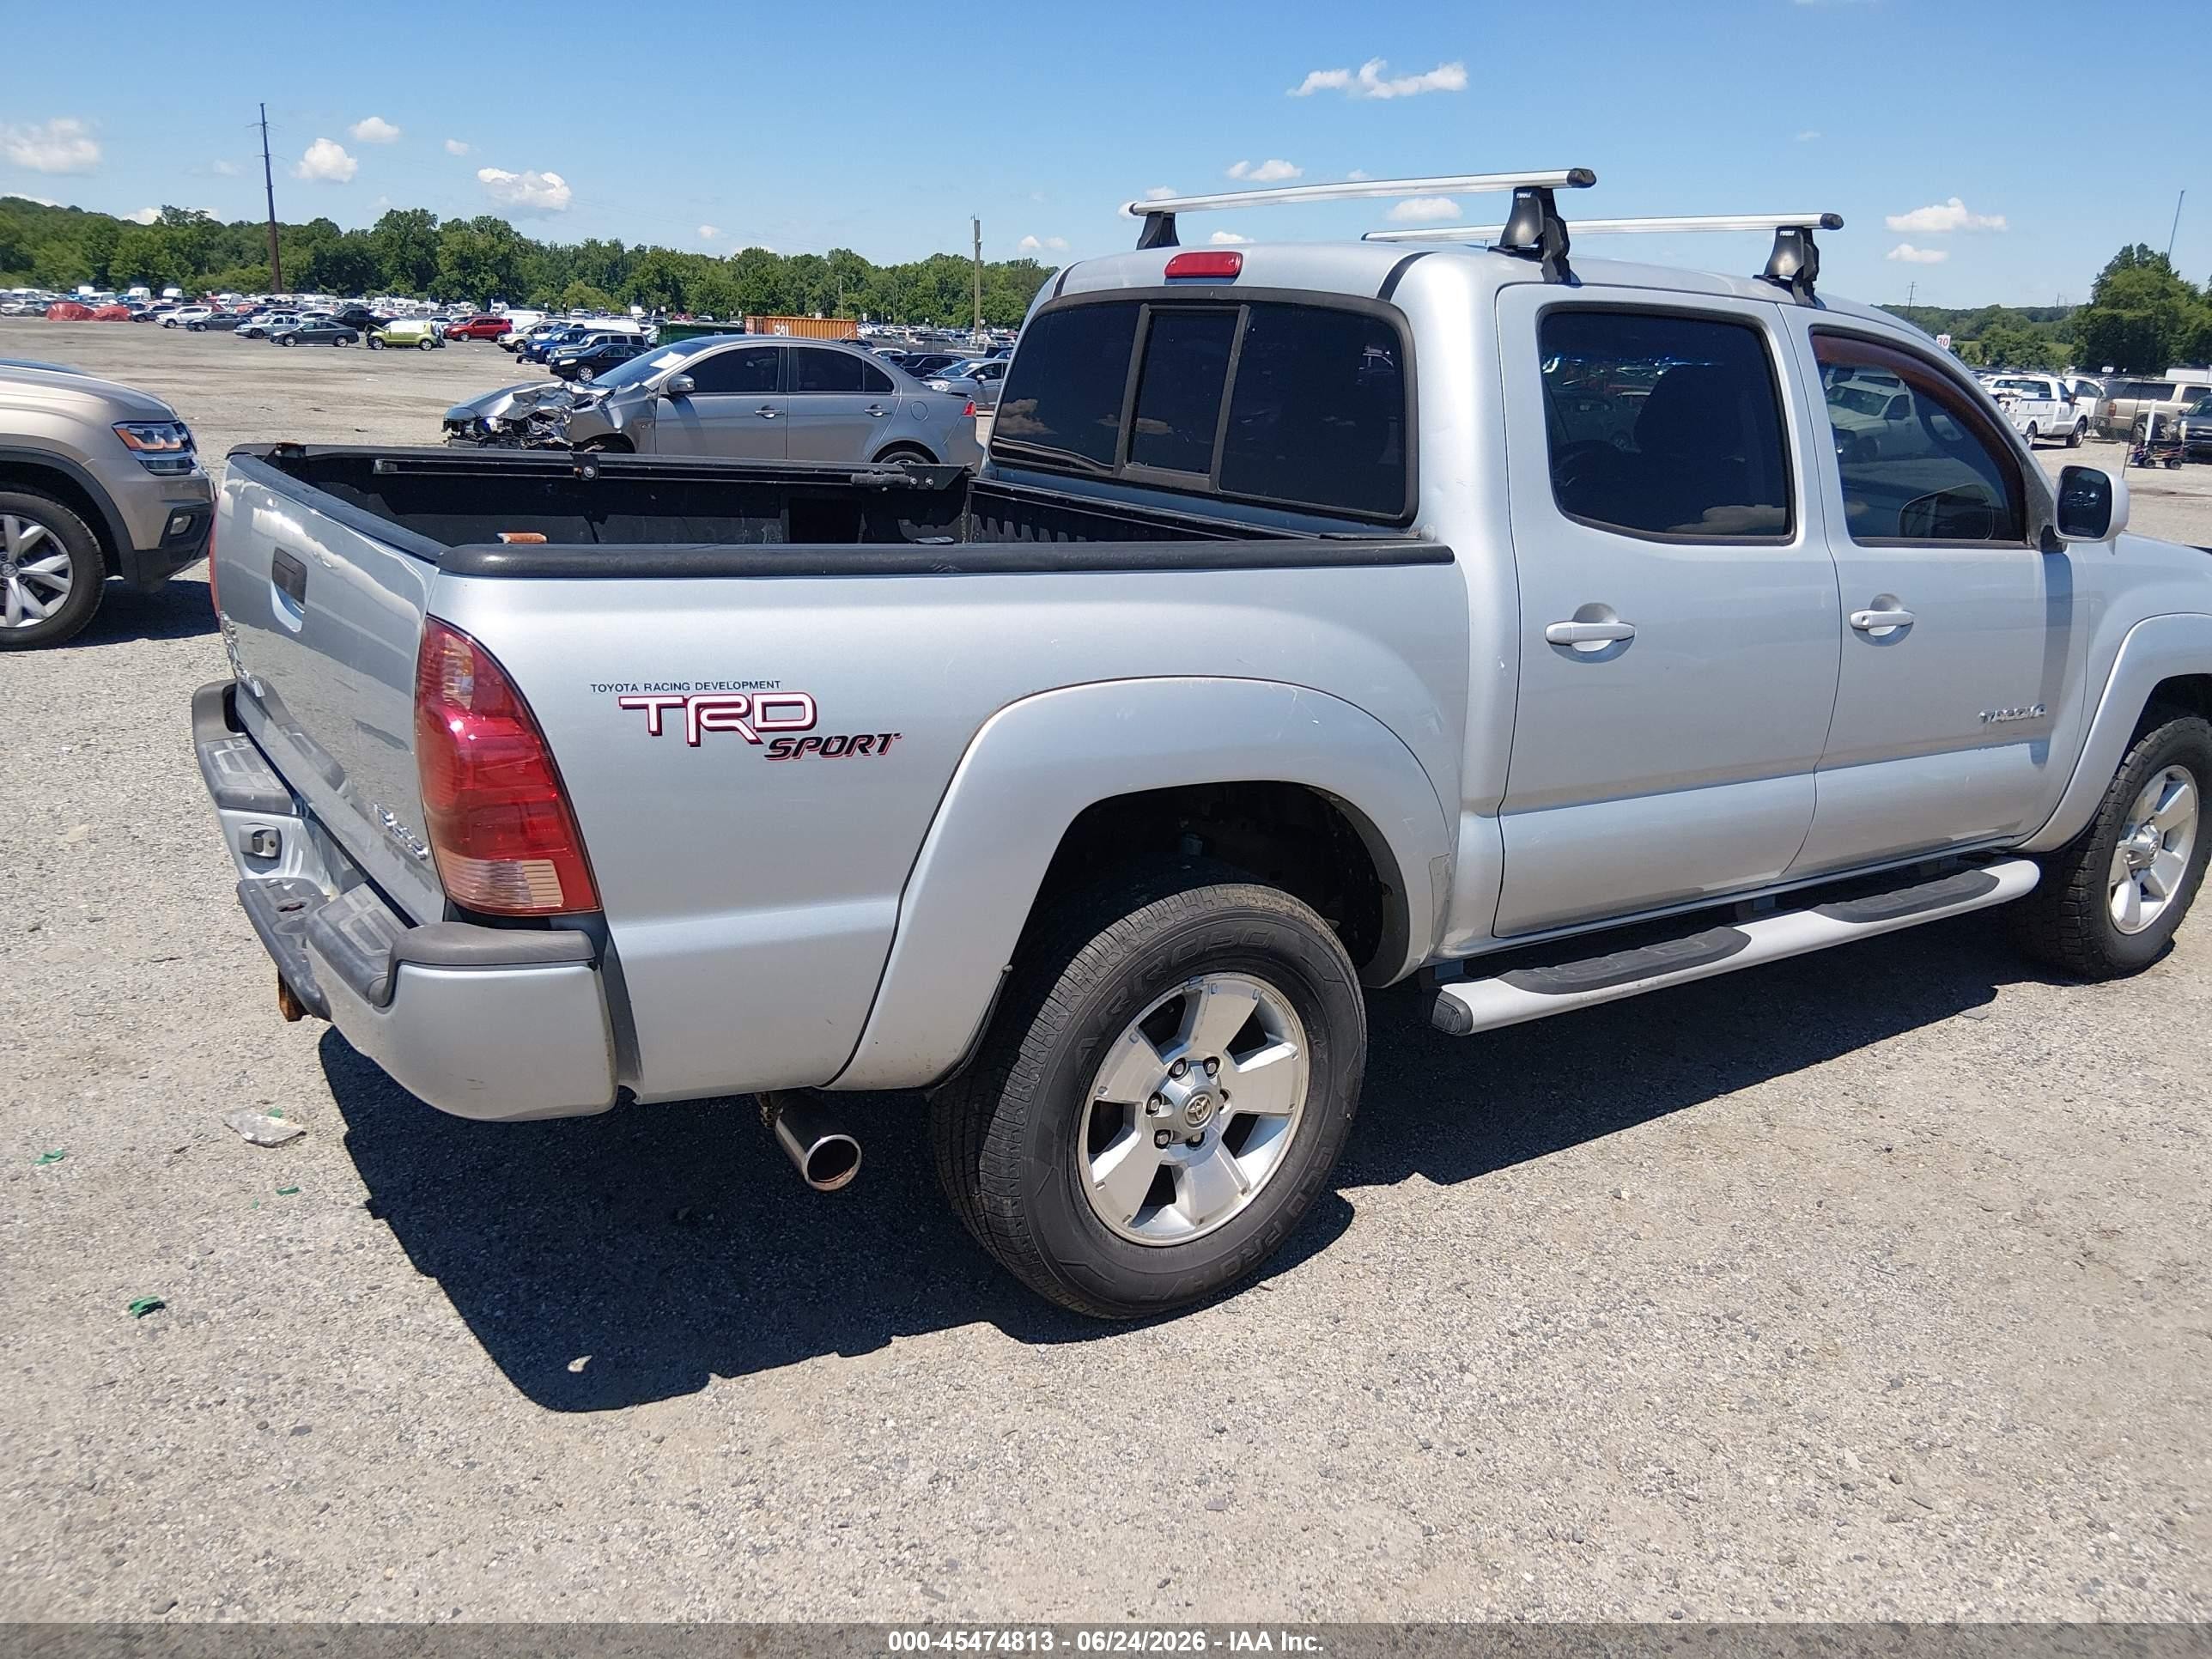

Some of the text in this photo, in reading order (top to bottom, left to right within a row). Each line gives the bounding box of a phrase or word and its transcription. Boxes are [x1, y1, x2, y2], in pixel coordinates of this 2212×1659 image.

[591, 680, 781, 692] TOYOTA RACING DEVELOPMENT
[617, 692, 817, 748] TRD
[763, 732, 902, 761] SPORT
